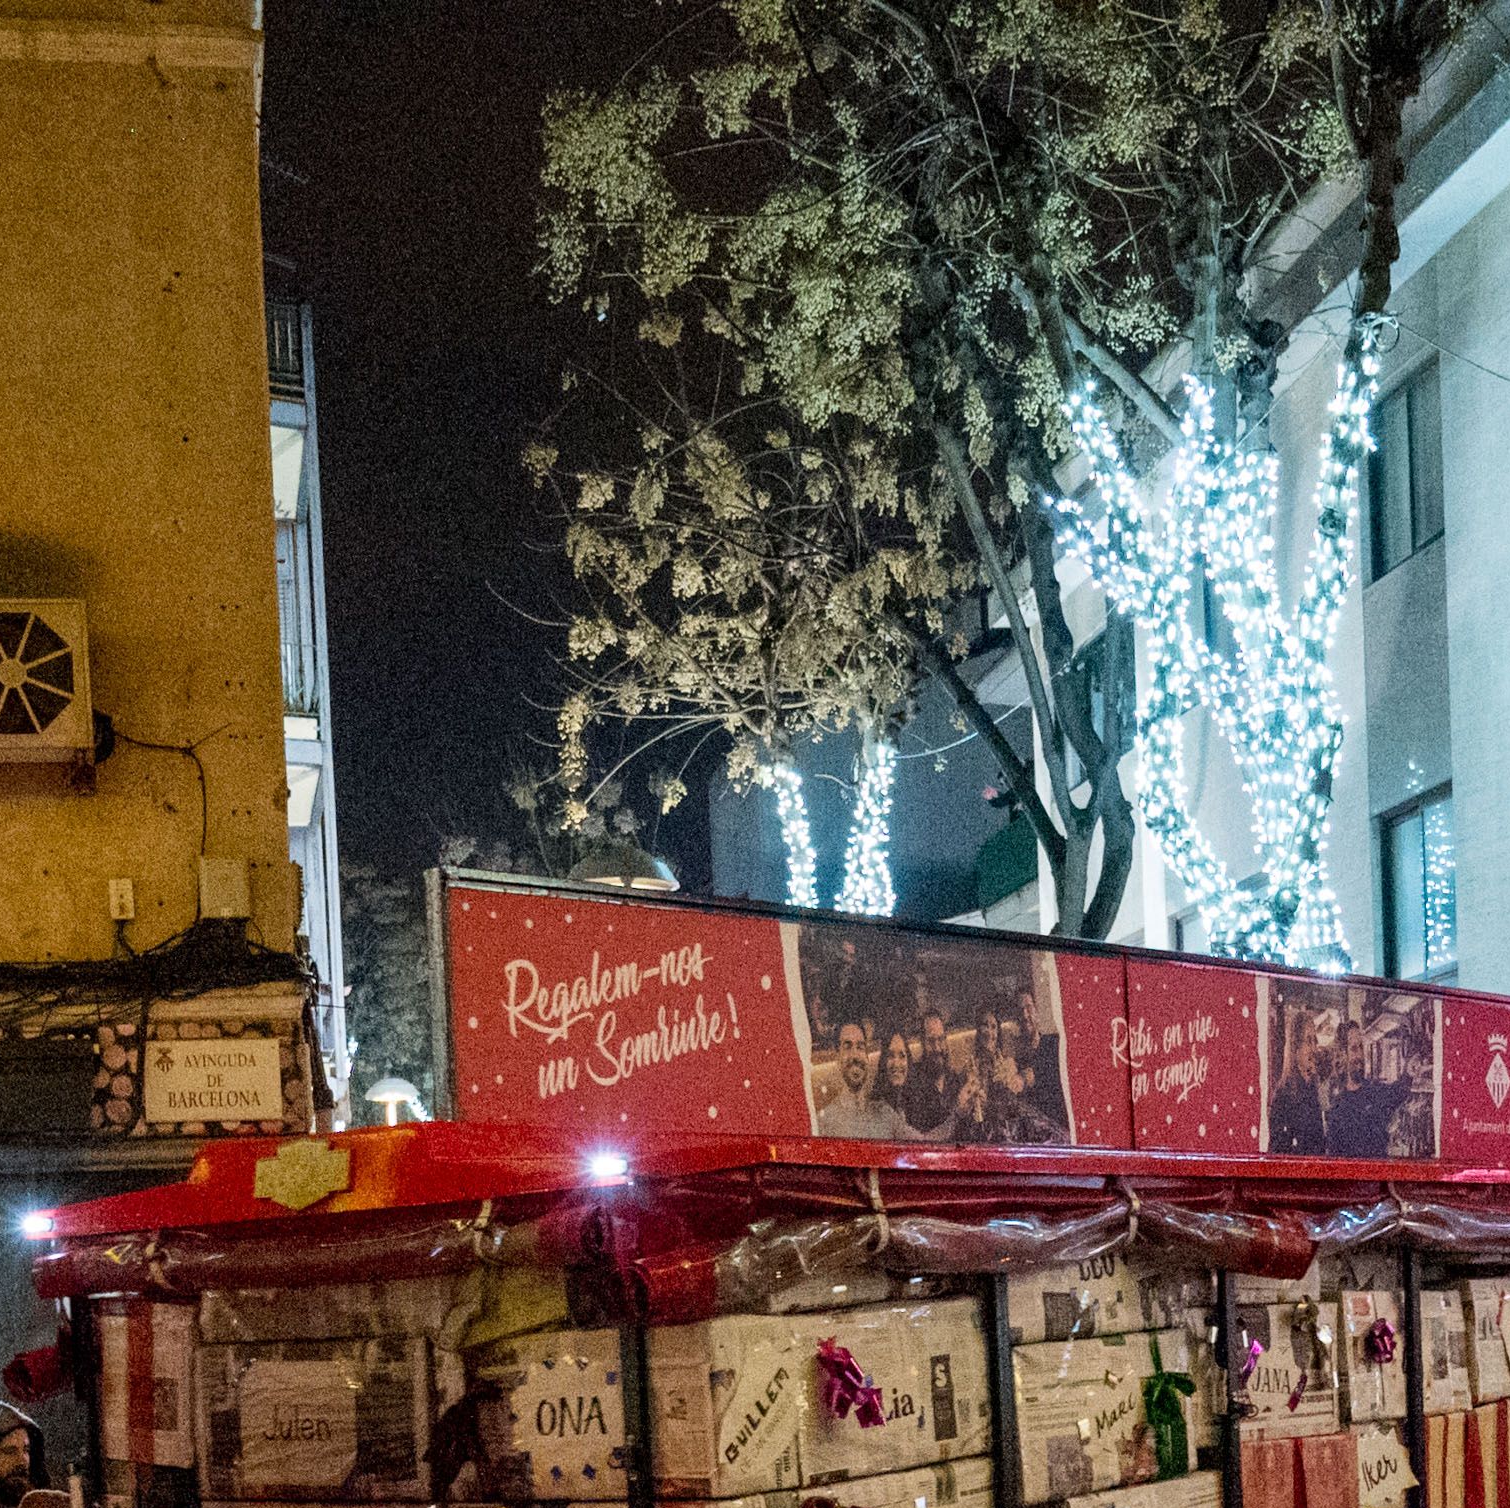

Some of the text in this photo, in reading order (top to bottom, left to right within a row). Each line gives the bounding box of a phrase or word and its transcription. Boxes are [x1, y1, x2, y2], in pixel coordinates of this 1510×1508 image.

[502, 942, 713, 1043] Regalem-nos
[183, 1052, 257, 1069] AVINGUDA
[538, 992, 743, 1099] un Somriure!
[1110, 1016, 1158, 1069] Rubí,
[1162, 1023, 1183, 1054] on
[206, 1073, 225, 1088] DE
[1131, 1042, 1210, 1105] on compro
[168, 1090, 262, 1109] BARCELONA
[1251, 1365, 1292, 1395] JANA
[536, 1395, 608, 1437] ONA
[723, 1366, 791, 1465] GUILLEM
[1361, 1454, 1398, 1493] Iker
